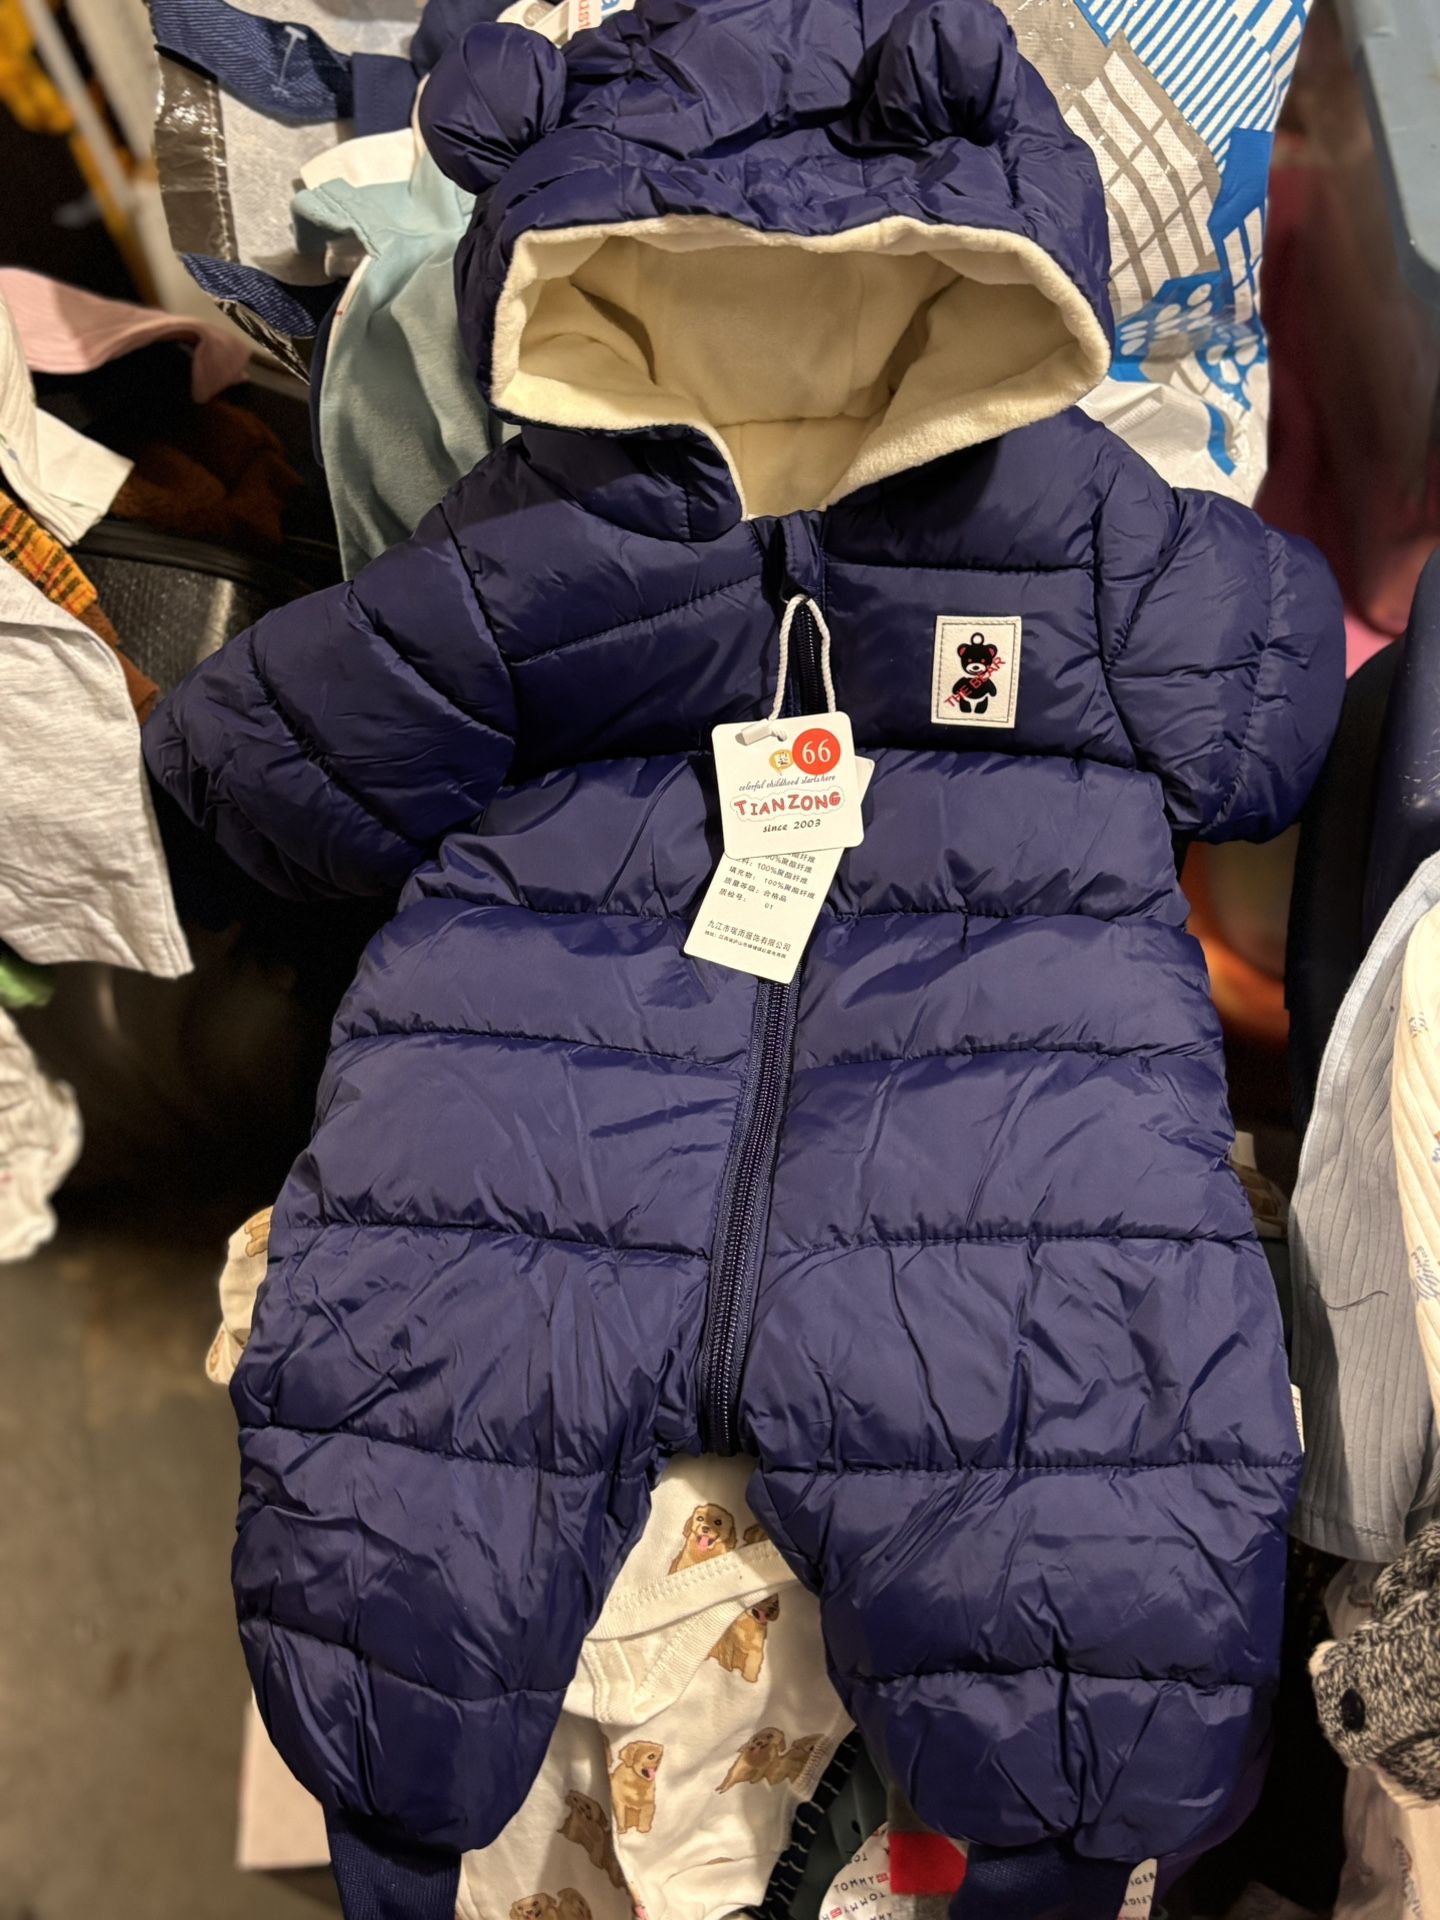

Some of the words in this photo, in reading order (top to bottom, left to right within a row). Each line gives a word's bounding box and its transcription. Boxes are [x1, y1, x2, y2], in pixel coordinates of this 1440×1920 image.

[944, 685, 973, 708] THE
[969, 656, 1006, 688] BEAR
[802, 739, 831, 765] 66
[734, 791, 841, 816] TIANZONG
[763, 823, 788, 833] since
[793, 818, 821, 830] 2003
[833, 1875, 874, 1893] TOMMY
[844, 1891, 886, 1914] TOMMY
